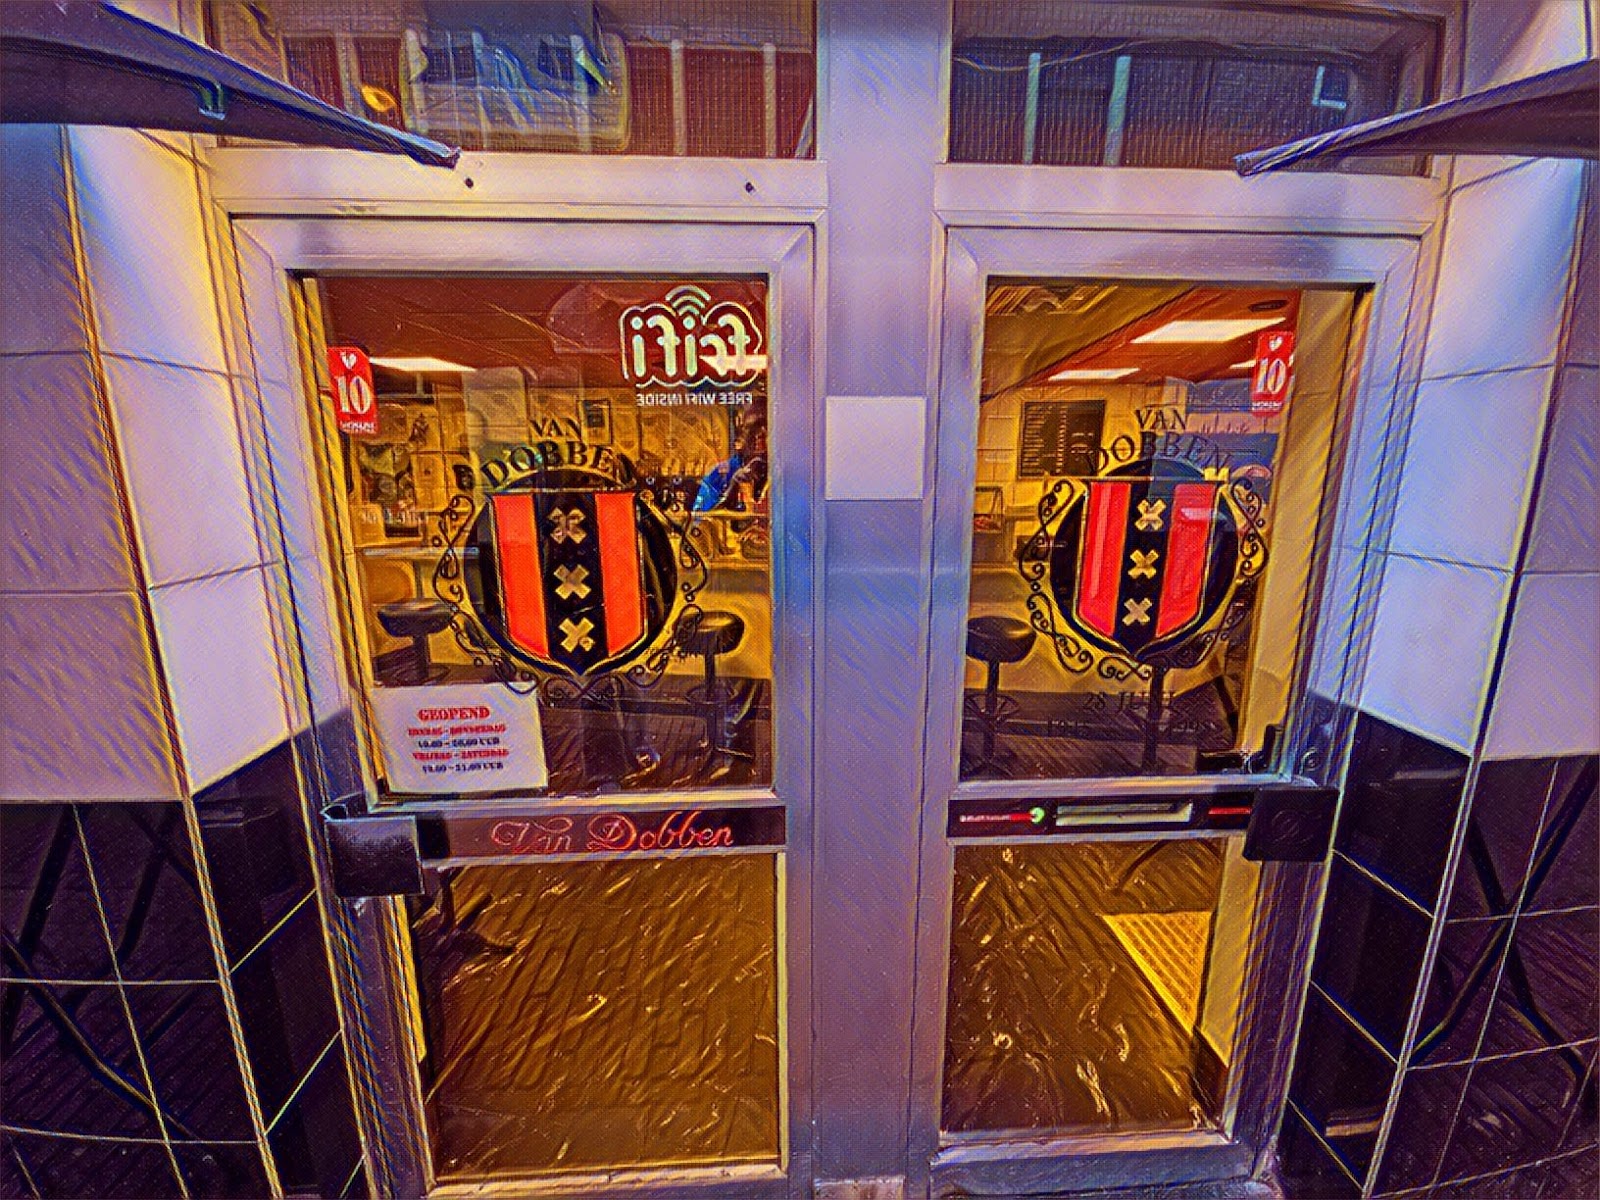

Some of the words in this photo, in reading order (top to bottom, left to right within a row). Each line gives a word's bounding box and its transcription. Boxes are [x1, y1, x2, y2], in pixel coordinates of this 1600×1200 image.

[334, 374, 372, 415] 10
[1256, 358, 1286, 394] 10
[530, 416, 582, 441] VAN
[1135, 408, 1187, 431] VAN
[480, 440, 637, 490] DOBBEN
[1083, 430, 1232, 479] DOBBEN
[418, 706, 490, 721] GEOPEND
[491, 816, 573, 853] Van
[586, 810, 734, 851] Dobben
